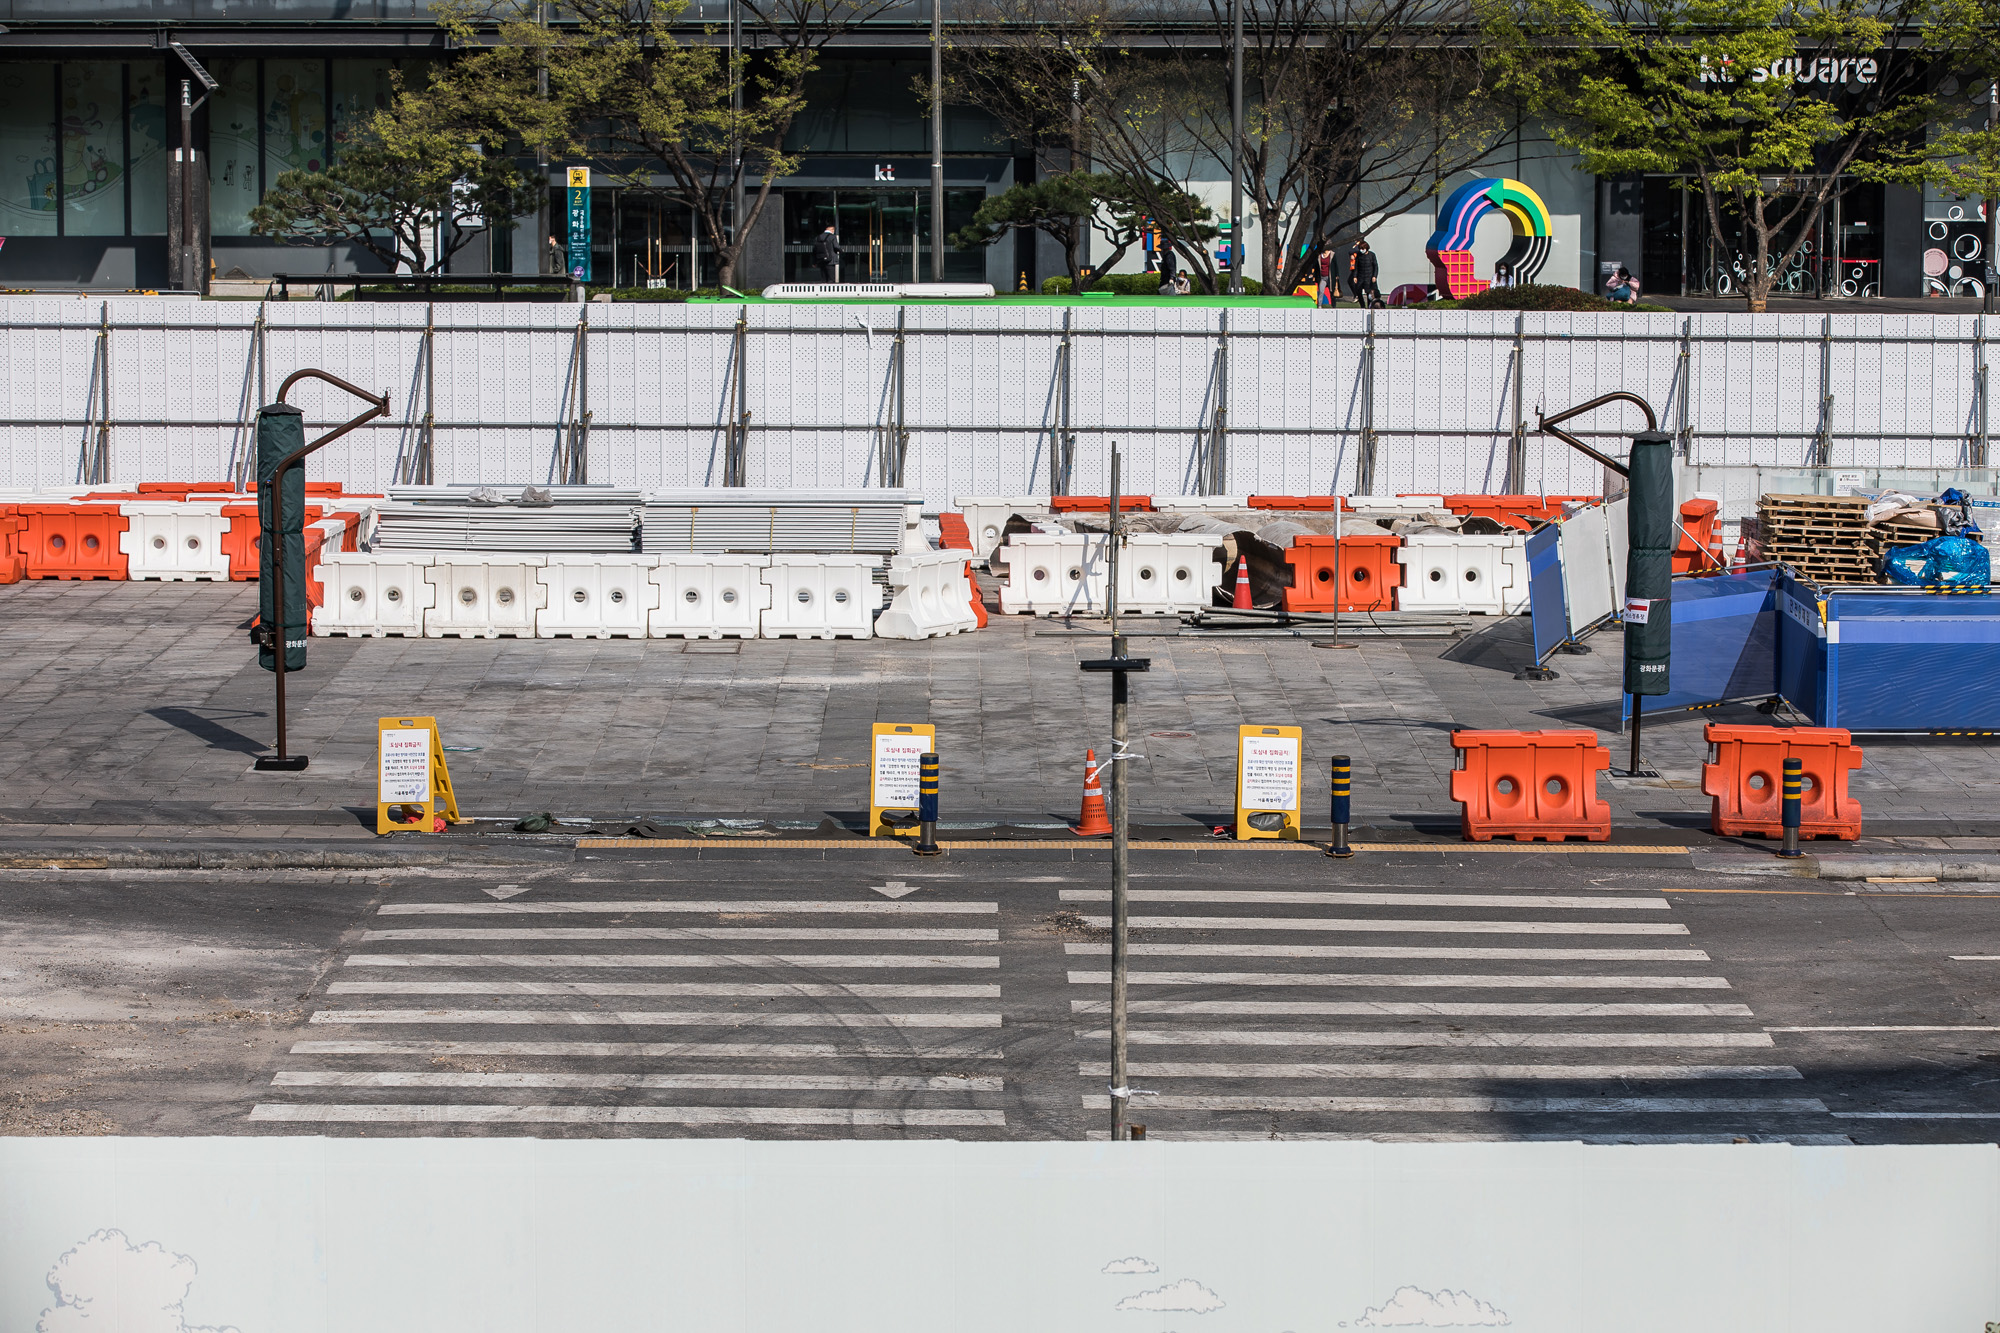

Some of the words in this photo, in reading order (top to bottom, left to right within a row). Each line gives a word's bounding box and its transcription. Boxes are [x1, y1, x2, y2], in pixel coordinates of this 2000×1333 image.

[1700, 53, 1735, 82] kt
[1751, 57, 1877, 90] square
[875, 164, 895, 181] kt
[575, 190, 581, 200] 2
